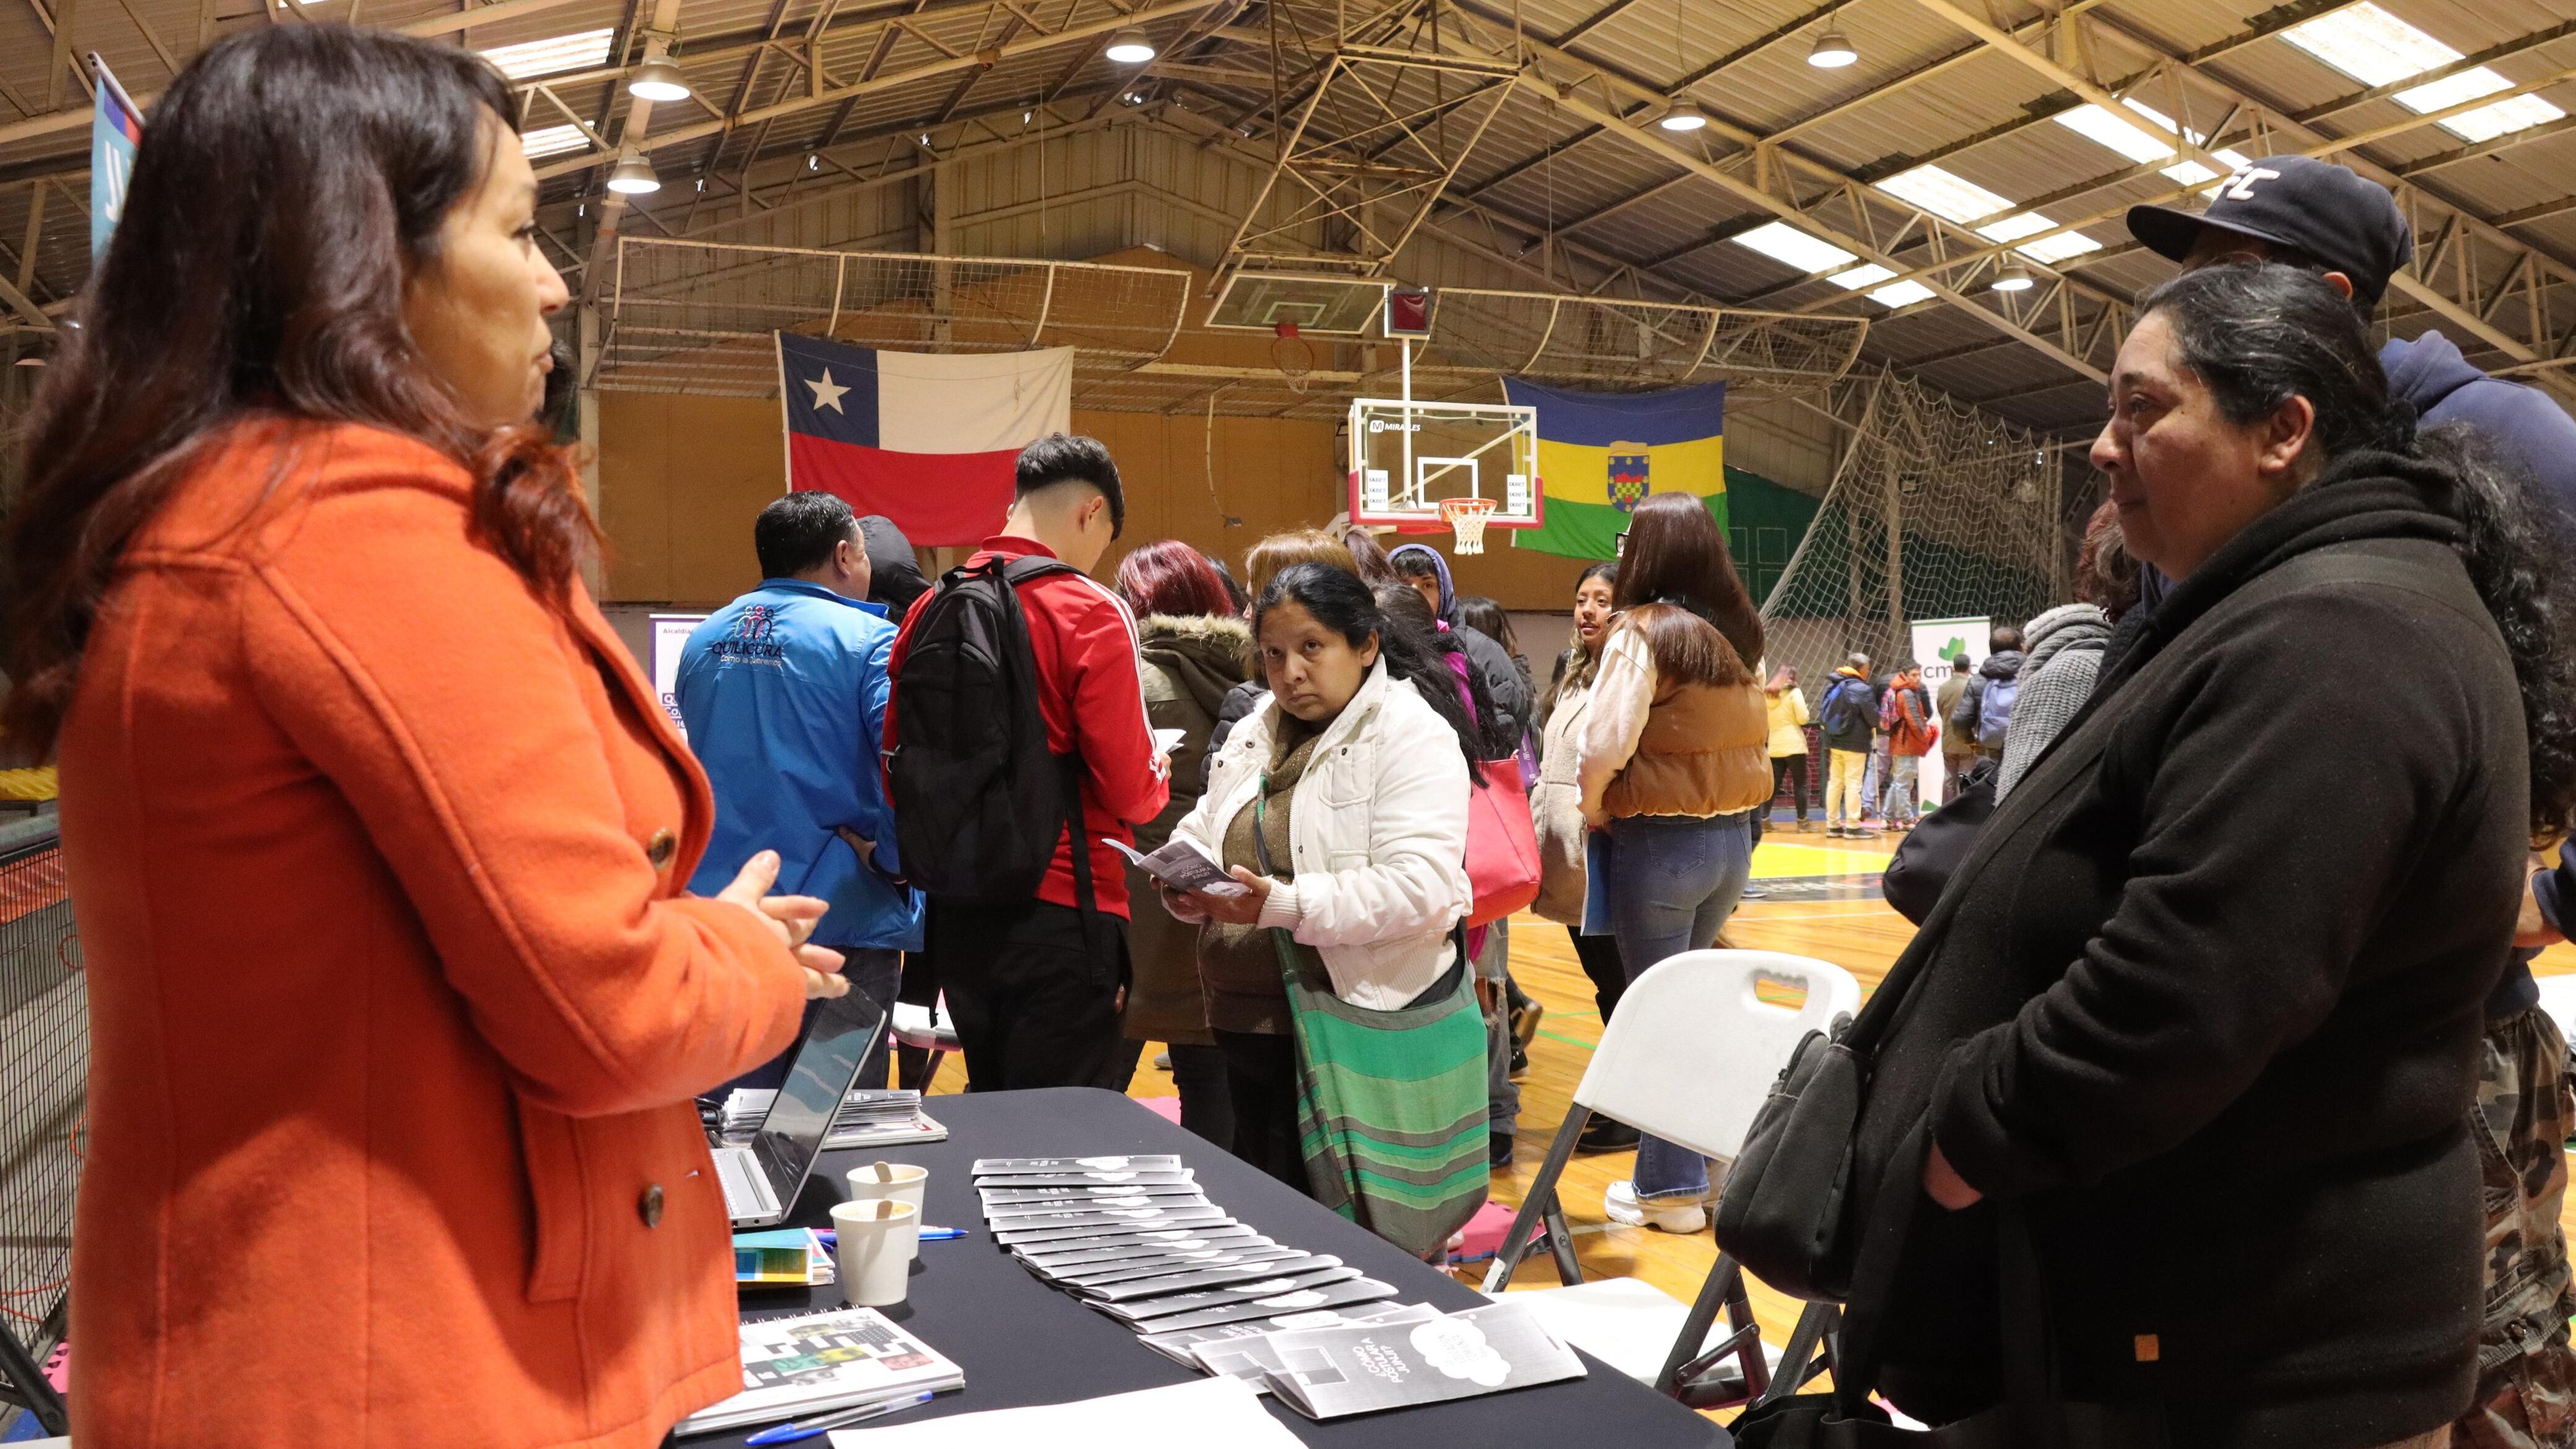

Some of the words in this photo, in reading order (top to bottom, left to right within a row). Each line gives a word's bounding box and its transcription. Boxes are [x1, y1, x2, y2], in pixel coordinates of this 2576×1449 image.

[712, 642, 782, 659] QUILICURA
[720, 655, 741, 663] Como
[1365, 1344, 1404, 1383] POSTULAR
[1380, 1345, 1411, 1373] JUNJI?
